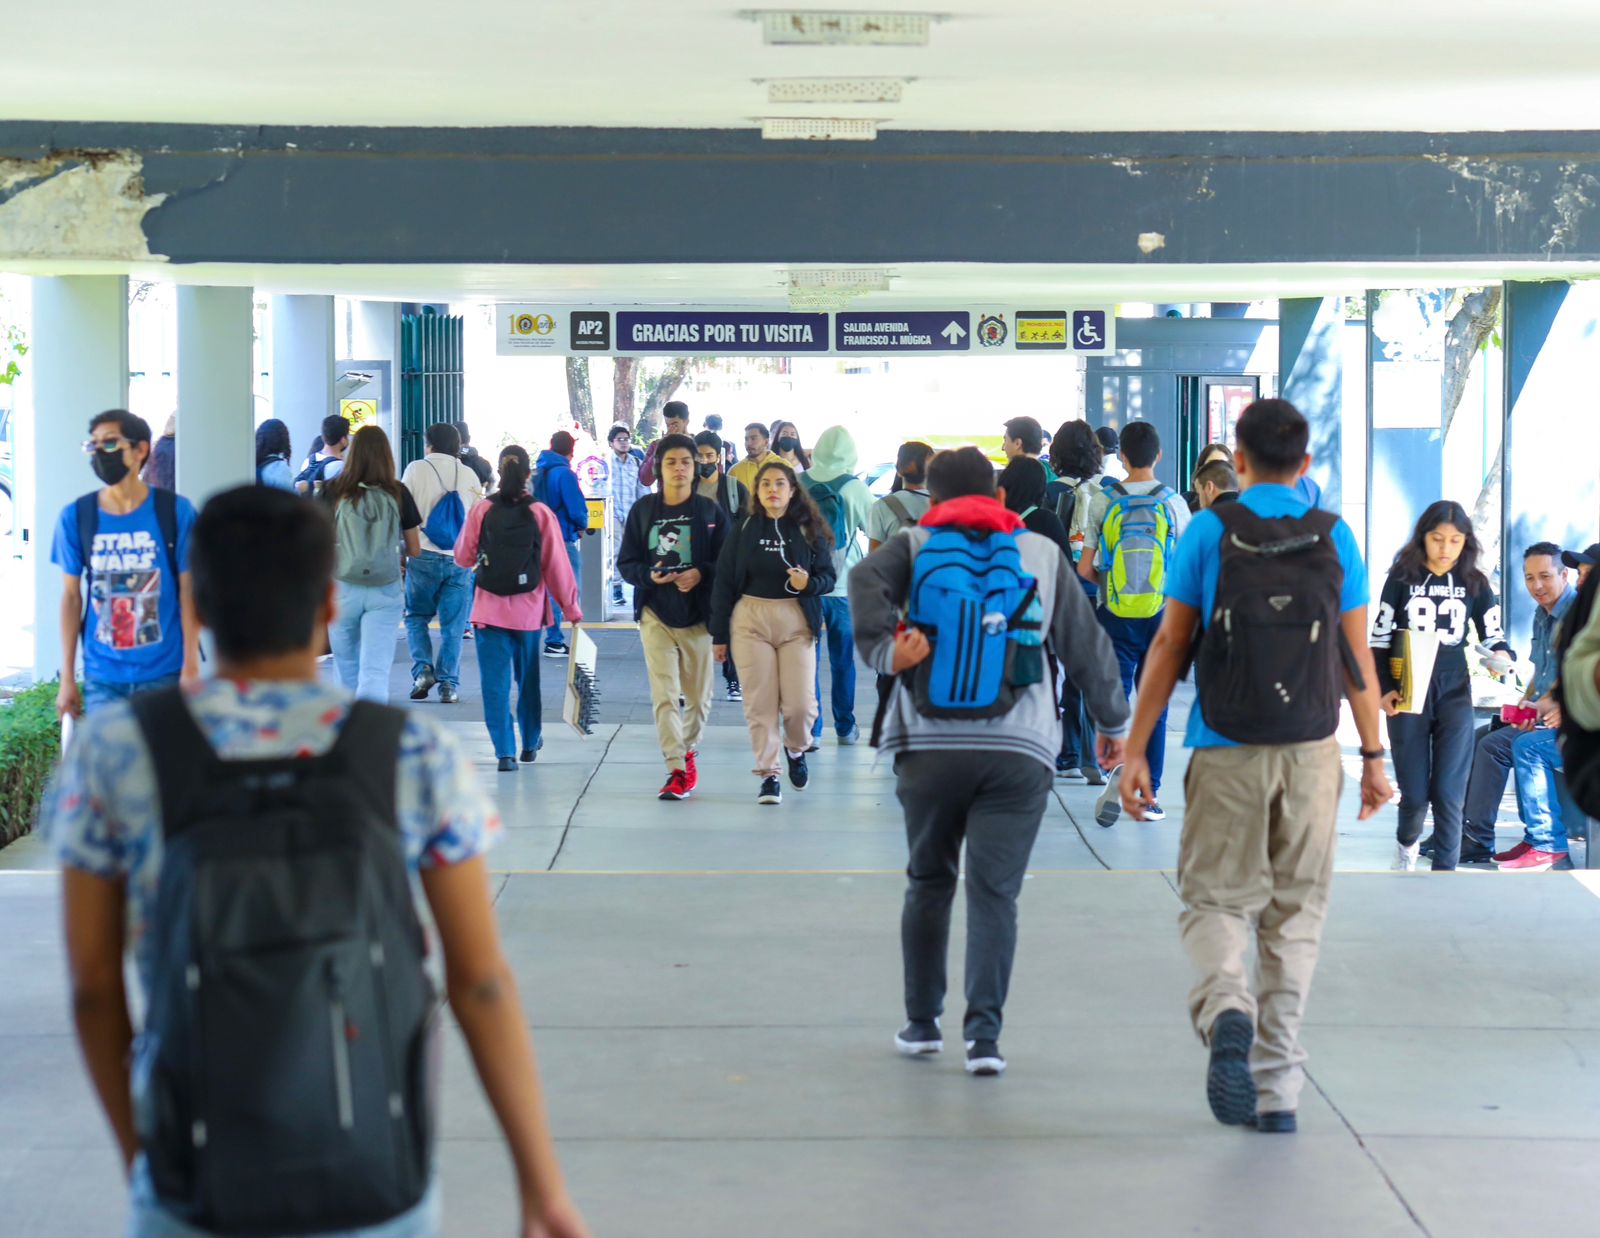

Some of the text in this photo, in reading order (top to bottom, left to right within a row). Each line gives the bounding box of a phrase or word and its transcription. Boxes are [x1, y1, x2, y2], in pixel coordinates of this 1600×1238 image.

[578, 320, 603, 335] AP2
[632, 324, 813, 343] GRACIAS POR TU VISITA
[843, 322, 909, 332] SALIDA AVENIDA
[843, 333, 932, 345] FRANCISCO J. MÚGICA
[92, 531, 156, 551] STAR
[90, 552, 156, 571] WARS
[1409, 585, 1466, 598] LOS ANGELES
[1407, 597, 1467, 646] 83
